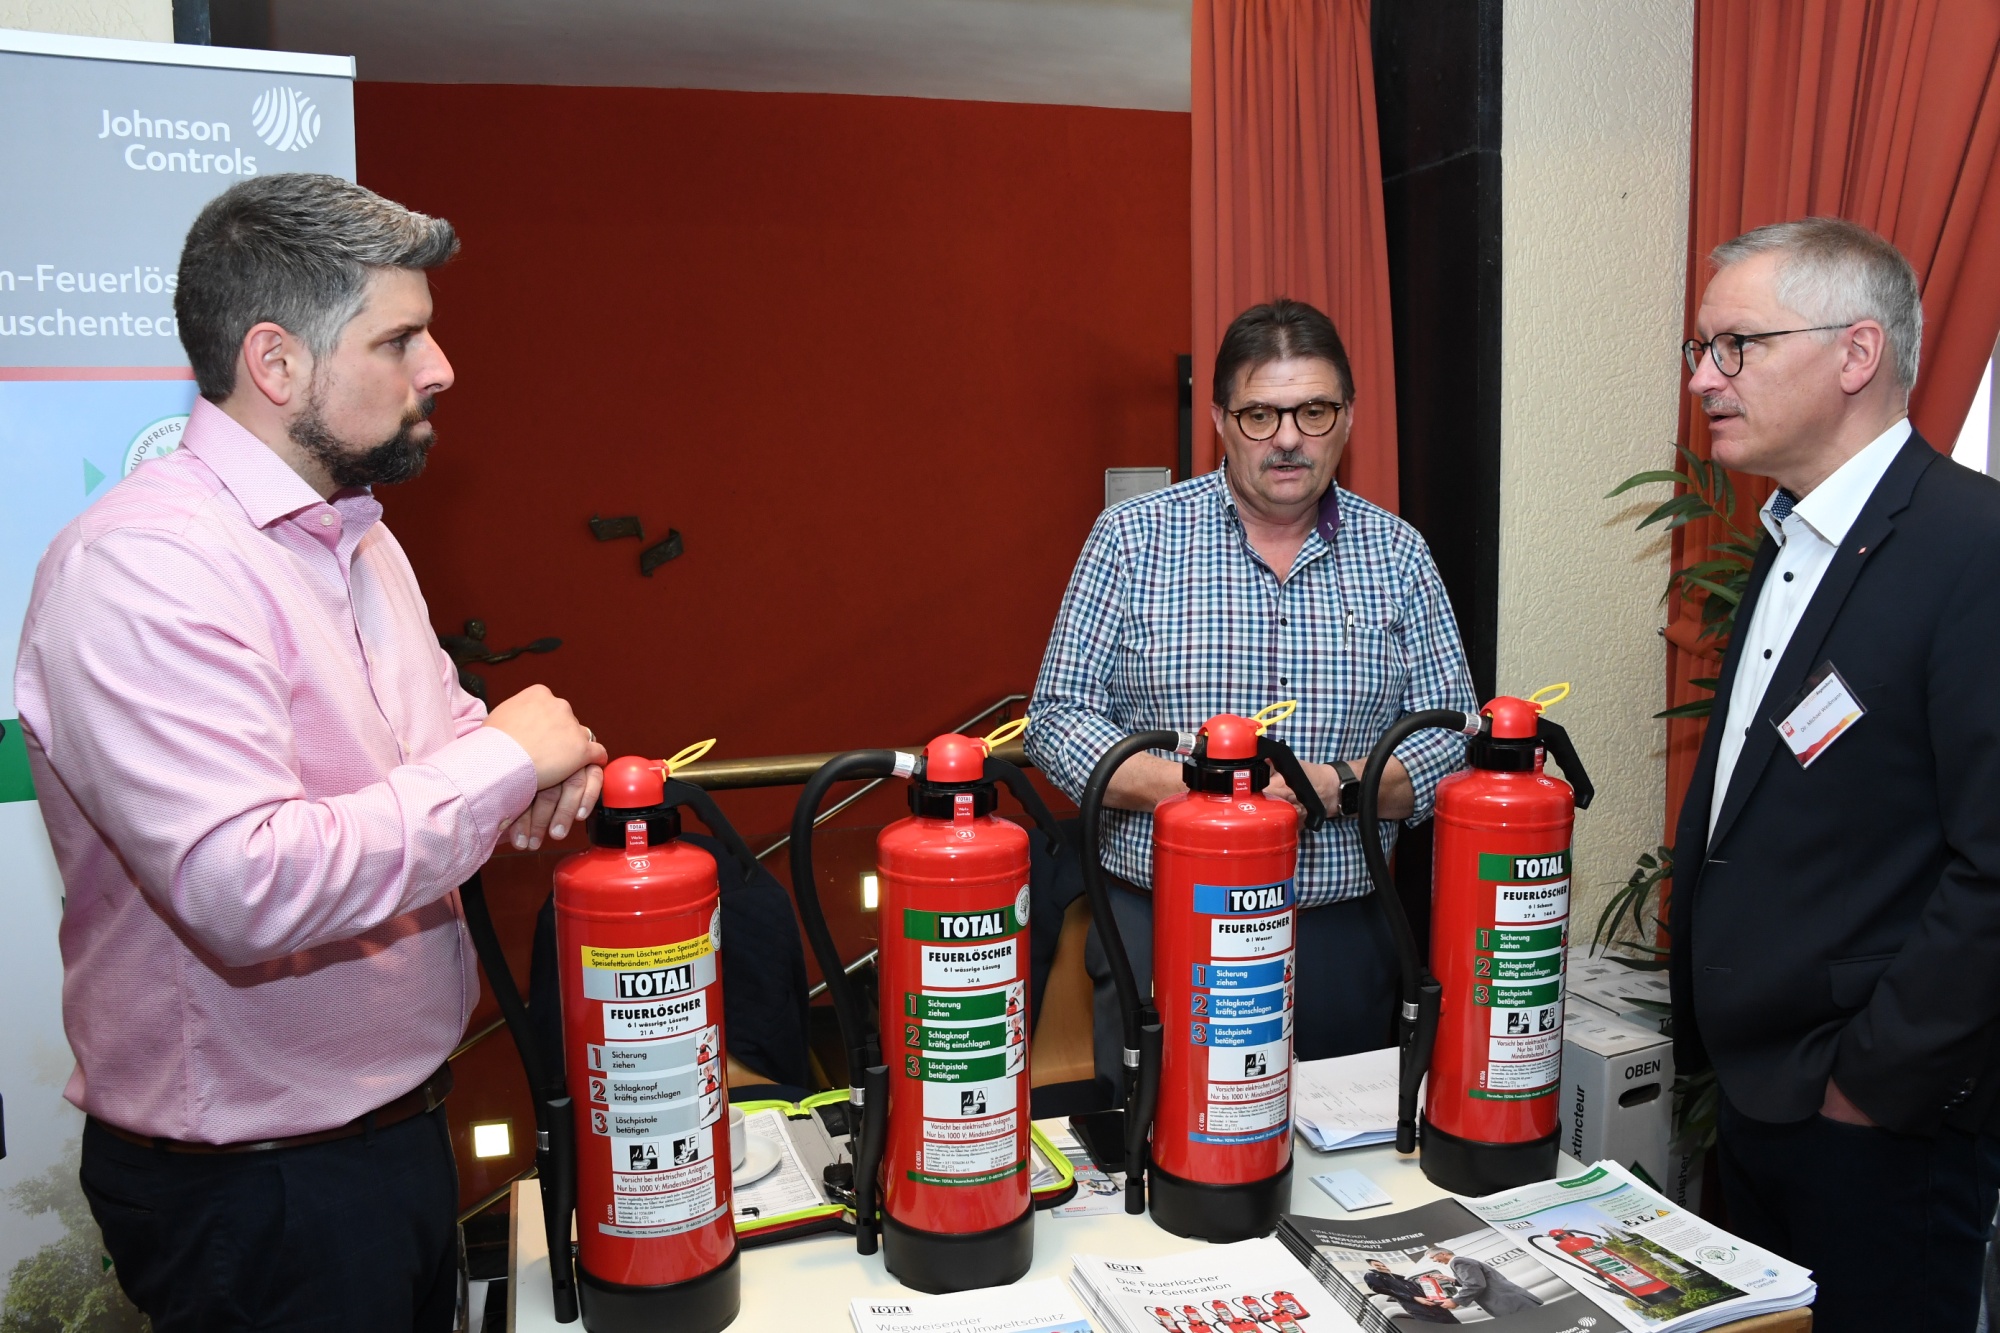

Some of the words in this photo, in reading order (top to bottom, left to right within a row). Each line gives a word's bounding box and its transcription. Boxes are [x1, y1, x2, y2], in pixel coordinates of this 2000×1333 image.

[98, 109, 231, 142] Johnson
[125, 144, 257, 175] Controls
[0, 265, 178, 294] n-Feuerlös
[1516, 856, 1563, 878] TOTAL
[1231, 886, 1284, 911] TOTAL
[1503, 885, 1567, 900] FEUERLÖSCHER
[940, 913, 1003, 938] TOTAL
[1218, 916, 1290, 933] FEUERLÖSCHER
[1481, 930, 1489, 948] 1
[1500, 933, 1530, 942] Sicherung
[591, 950, 618, 959] Geeignet
[636, 949, 662, 958] Löschen
[654, 951, 700, 965] Mindestabstand
[928, 946, 1012, 962] FEUERLÖSCHER
[982, 963, 1001, 971] Lösung
[1476, 958, 1491, 977] 2
[1499, 960, 1535, 969] Schlagknopf
[1196, 965, 1206, 985] 1
[1216, 970, 1248, 978] Sicherung
[1498, 968, 1519, 978] kräftig
[1520, 968, 1551, 977] einschlagen
[621, 967, 690, 997] TOTAL
[1475, 986, 1490, 1004] 3
[1497, 990, 1533, 998] Löschpistole
[611, 998, 701, 1020] FEUERLÖSCHER
[908, 995, 917, 1015] 1
[927, 1000, 961, 1009] Sicherung
[1193, 995, 1208, 1015] 2
[1215, 998, 1255, 1008] Schlagknopf
[1497, 998, 1526, 1006] betätigen
[1215, 1007, 1237, 1017] kräftig
[1238, 1005, 1272, 1015] einschlagen
[1521, 1012, 1530, 1022] A
[1549, 1007, 1555, 1017] B
[638, 1020, 667, 1029] wässrige
[668, 1016, 689, 1024] Lösung
[906, 1025, 920, 1046] 2
[928, 1031, 970, 1040] Schlagknopf
[1192, 1024, 1207, 1043] 3
[1215, 1028, 1253, 1037] Löschpistole
[928, 1040, 950, 1050] kräftig
[951, 1039, 991, 1048] einschlagen
[1214, 1037, 1245, 1045] betätigen
[592, 1047, 602, 1069] 1
[611, 1051, 647, 1060] Sicherung
[1258, 1053, 1266, 1062] A
[612, 1061, 636, 1069] ziehen
[907, 1056, 920, 1076] 3
[928, 1062, 968, 1071] Löschpistole
[1624, 1059, 1661, 1080] OBEN
[928, 1071, 960, 1080] betätigen
[591, 1079, 607, 1102] 2
[613, 1081, 658, 1093] Schlagknopf
[1215, 1085, 1236, 1093] Vorsicht
[1245, 1082, 1271, 1091] elektrischen
[614, 1093, 638, 1103] kräftig
[639, 1089, 681, 1101] einschlagen
[976, 1090, 986, 1101] A
[594, 1112, 608, 1134] 3
[615, 1116, 658, 1125] Löschpistole
[930, 1122, 951, 1130] Vorsicht
[961, 1120, 992, 1130] elektrischen
[1573, 1084, 1586, 1161] xtincteur
[616, 1126, 650, 1135] betätigen
[937, 1131, 946, 1139] bis
[968, 1125, 1006, 1138] Mindestabstand
[646, 1145, 657, 1156] A
[689, 1136, 696, 1148] F
[620, 1175, 643, 1183] Vorsicht
[643, 1175, 653, 1183] bei
[654, 1171, 687, 1182] elektrischen
[628, 1184, 637, 1192] bis
[639, 1184, 653, 1192] 1000
[661, 1174, 703, 1189] Mindestabstand
[1392, 1232, 1425, 1242] PARTNER
[1485, 1248, 1527, 1267] TOTAL
[1105, 1262, 1143, 1272] TOTAL
[1115, 1277, 1137, 1286] Die
[1122, 1286, 1141, 1294] der
[1147, 1282, 1232, 1296] X-Generation
[871, 1306, 911, 1314] TOTAL
[875, 1317, 982, 1332] Wegweisender
[966, 1313, 1065, 1333] Umweltschutz
